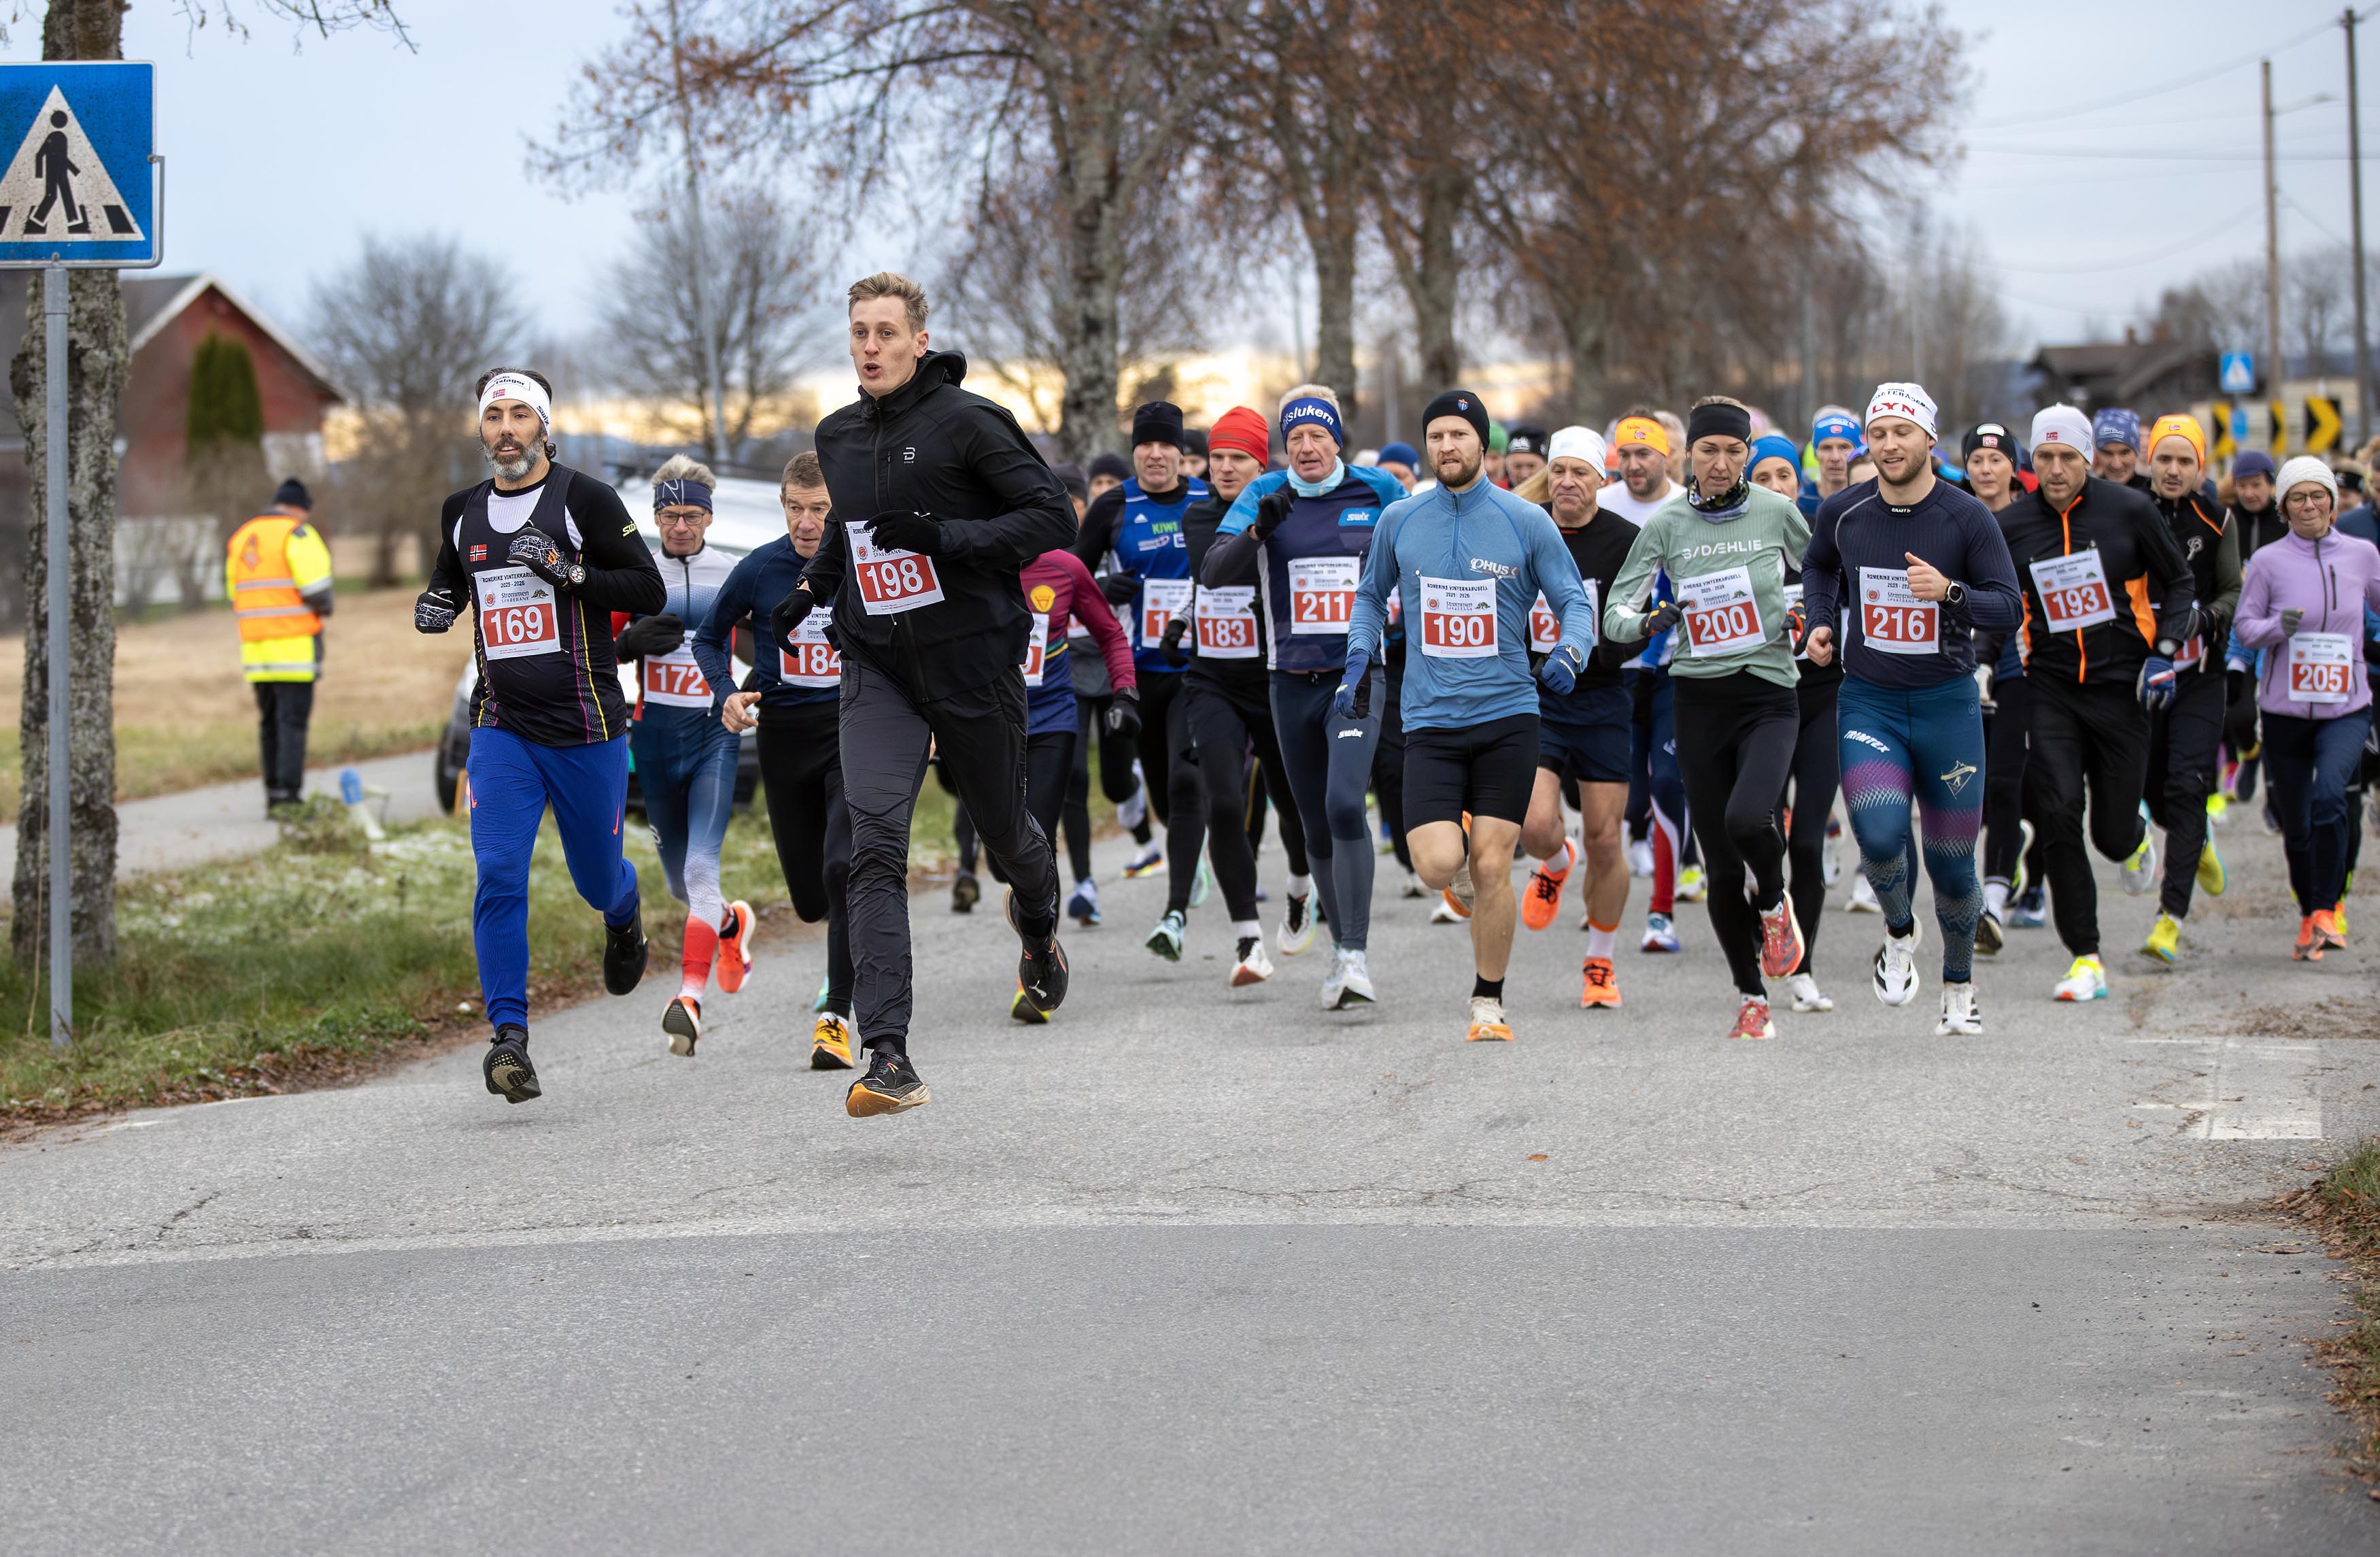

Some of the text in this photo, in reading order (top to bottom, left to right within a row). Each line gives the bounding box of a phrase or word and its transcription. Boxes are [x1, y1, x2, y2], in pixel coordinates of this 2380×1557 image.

[1872, 402, 1916, 416] LYN
[866, 558, 923, 599] 198
[1302, 592, 1346, 621] 211
[2052, 586, 2100, 618] 193
[490, 606, 543, 643] 169
[1204, 619, 1246, 646] 183
[1433, 616, 1484, 646] 190
[1695, 605, 1749, 643] 200
[1872, 607, 1926, 641] 216
[798, 644, 842, 675] 184
[656, 665, 704, 694] 172
[2298, 664, 2343, 692] 205
